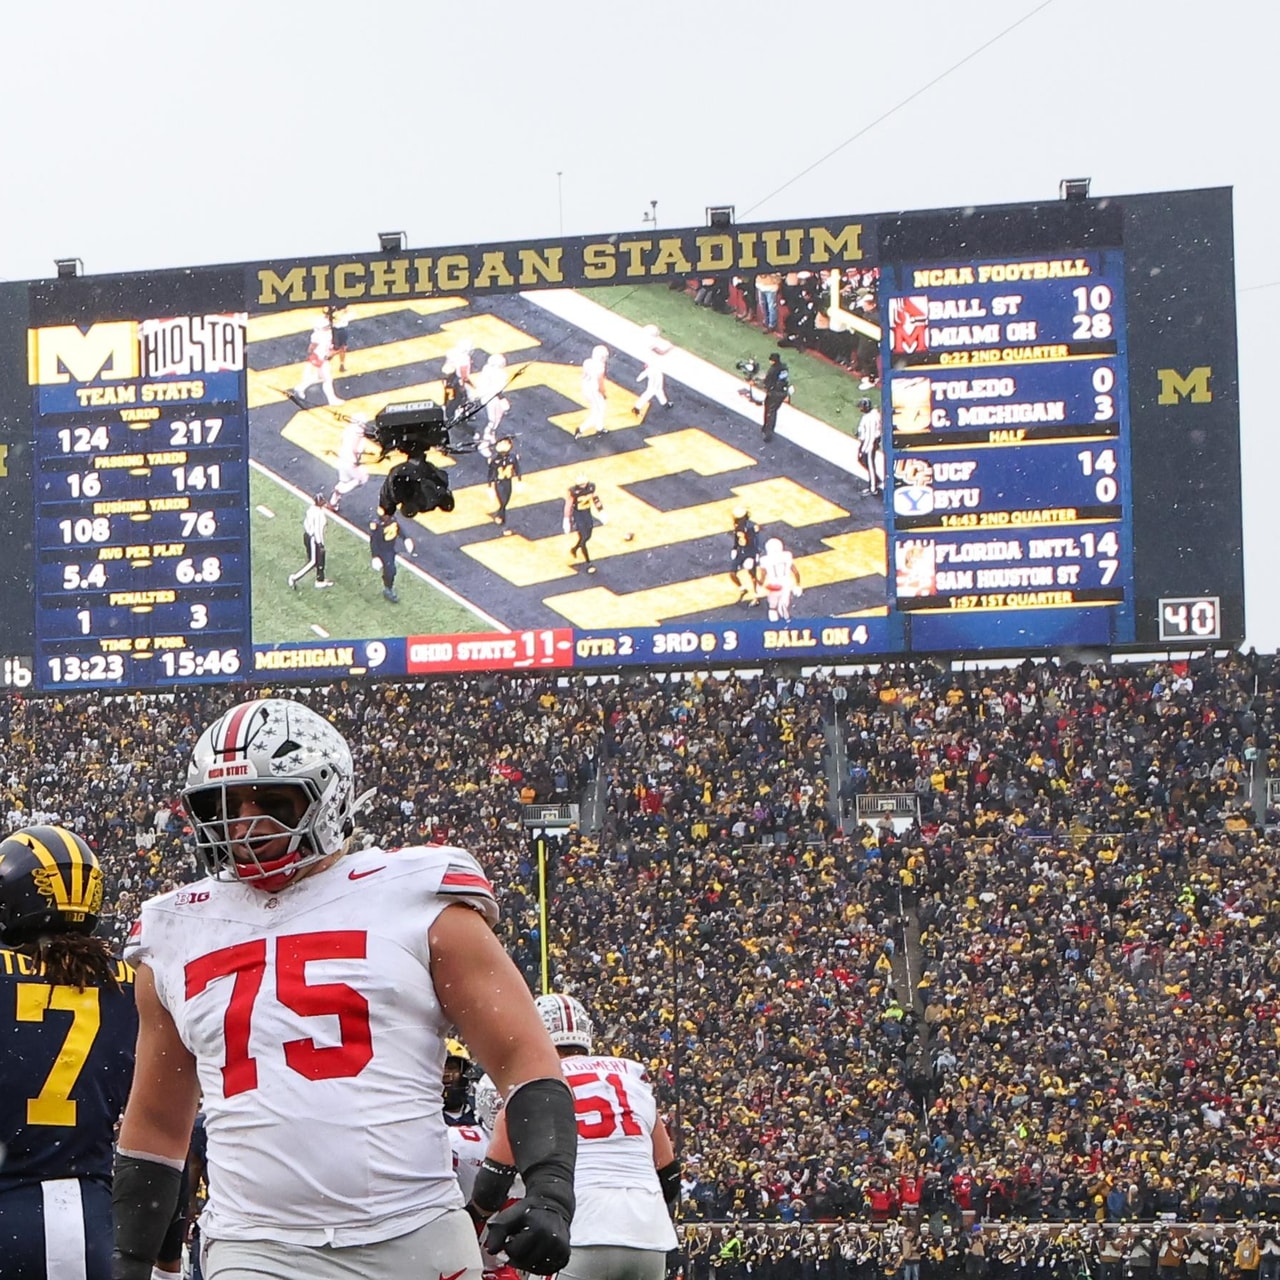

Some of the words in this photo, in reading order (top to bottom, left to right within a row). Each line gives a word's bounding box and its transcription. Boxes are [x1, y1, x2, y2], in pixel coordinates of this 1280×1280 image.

[258, 247, 564, 304] MICHIGAN
[583, 224, 863, 280] STADIUM
[913, 266, 975, 288] NCAA
[978, 259, 1090, 283] FOOTBALL
[928, 298, 986, 320] BALL
[991, 296, 1022, 315] ST
[1072, 285, 1112, 312] 10
[930, 324, 1000, 347] MIAMI
[1006, 321, 1037, 341] OH
[1072, 313, 1112, 340] 28
[940, 351, 969, 365] 0:22
[971, 348, 1000, 363] 2ND
[1002, 344, 1069, 361] QUARTER
[931, 378, 1016, 401] TOLEDO
[1092, 367, 1114, 392] 0
[1157, 366, 1212, 405] M
[76, 384, 137, 406] TEAM
[141, 380, 204, 402] STATS
[120, 407, 161, 422] YARDS
[931, 409, 951, 428] C.
[957, 401, 1065, 426] MICHIGAN
[1094, 395, 1114, 420] 3
[58, 426, 109, 452] 124
[170, 418, 223, 446] 217
[989, 429, 1027, 443] HALF
[94, 454, 145, 469] PASSING
[146, 451, 187, 466] YARDS
[932, 461, 977, 482] UCF
[1078, 449, 1117, 476] 14
[67, 472, 102, 498] 16
[172, 465, 221, 492] 141
[1096, 477, 1117, 502] 0
[93, 500, 147, 515] RUSHING
[148, 497, 190, 512] YARDS
[933, 488, 981, 510] BYU
[59, 517, 110, 544] 108
[180, 511, 217, 537] 76
[941, 513, 978, 527] 14:43
[980, 511, 1010, 525] 2ND
[1011, 508, 1077, 524] QUARTER
[98, 547, 123, 560] AVG
[126, 545, 150, 559] PER
[153, 543, 186, 557] PLAY
[935, 541, 1023, 563] FLORIDA
[1080, 531, 1118, 558] 14
[63, 563, 107, 590] 5.4
[175, 557, 221, 584] 6.8
[935, 570, 973, 590] SAM
[977, 567, 1054, 588] HOUSTON
[1056, 565, 1081, 584] ST
[1098, 560, 1119, 585] 7
[109, 590, 176, 606] PENALTIES
[949, 595, 978, 608] 1:57
[980, 593, 1005, 607] 1ST
[1007, 591, 1073, 605] QUARTER
[77, 609, 91, 635] 1
[190, 603, 208, 629] 3
[1164, 603, 1215, 635] 40
[99, 639, 133, 652] TIME
[135, 637, 152, 650] OF
[154, 635, 187, 649] POSS.
[520, 630, 555, 657] 11
[576, 638, 615, 657] QTR
[618, 635, 633, 655] 2
[652, 632, 698, 653] 3RD
[700, 632, 718, 651] &
[722, 630, 738, 650] 3
[763, 629, 816, 648] BALL
[822, 628, 850, 646] ON
[852, 624, 868, 644] 4
[161, 649, 240, 677] 15:46
[254, 647, 354, 670] MICHIGAN
[365, 640, 387, 668] 9
[410, 643, 453, 663] OHIO
[458, 639, 517, 661] STATE
[48, 654, 124, 683] 13:23
[226, 764, 249, 776] STATE
[184, 930, 374, 1099] 75
[15, 983, 101, 1127] 7
[566, 1072, 643, 1140] 51
